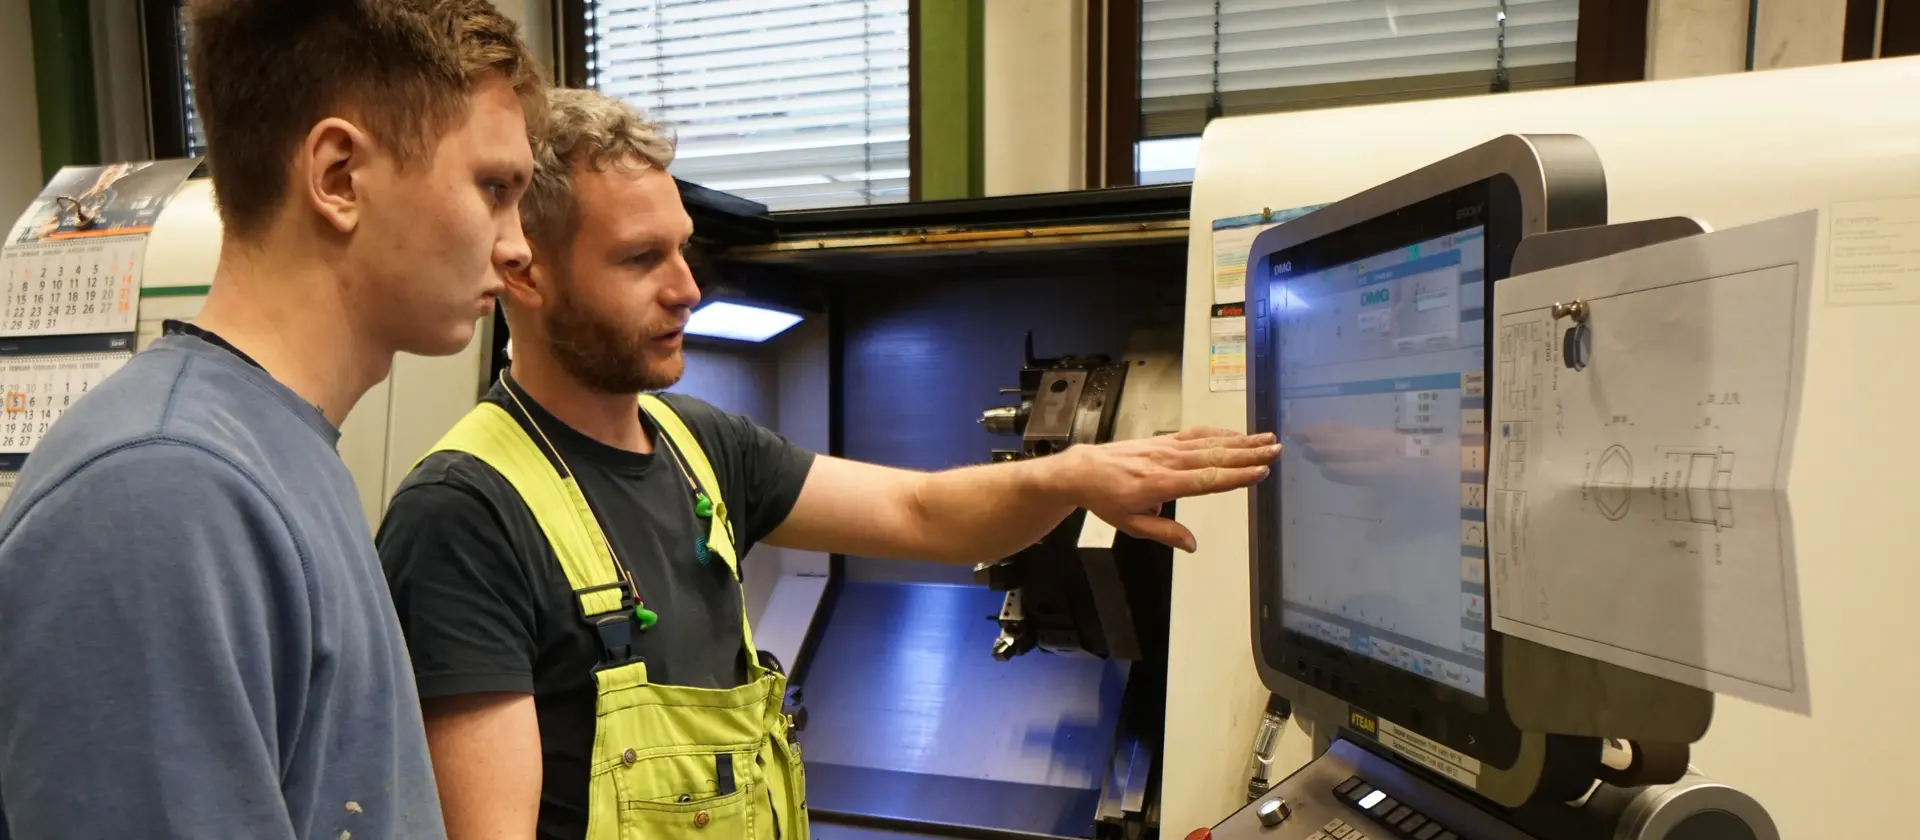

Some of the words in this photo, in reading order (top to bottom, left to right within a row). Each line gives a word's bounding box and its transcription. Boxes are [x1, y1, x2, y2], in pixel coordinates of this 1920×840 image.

[40, 268, 47, 278] 2
[58, 266, 64, 277] 3
[75, 265, 81, 275] 4
[92, 264, 99, 274] 5
[1274, 260, 1292, 276] DMG
[22, 282, 28, 292] 8
[39, 281, 46, 291] 9
[52, 279, 63, 290] 10
[69, 278, 79, 289] 11
[87, 277, 97, 288] 12
[104, 276, 115, 286] 13
[17, 294, 27, 305] 15
[34, 294, 44, 304] 16
[51, 292, 61, 303] 17
[68, 292, 78, 302] 18
[85, 290, 96, 301] 19
[101, 289, 114, 300] 20
[1361, 288, 1390, 306] DMG
[13, 307, 25, 318] 22
[30, 306, 42, 317] 23
[47, 305, 60, 316] 24
[65, 304, 77, 315] 25
[82, 304, 94, 314] 26
[100, 302, 112, 313] 27
[11, 320, 23, 330] 29
[28, 319, 40, 330] 30
[45, 318, 57, 329] 31
[82, 382, 88, 392] 2
[13, 396, 19, 407] 5
[30, 396, 36, 407] 6
[47, 396, 52, 406] 7
[64, 396, 69, 406] 8
[8, 410, 17, 420] 12
[25, 410, 34, 420] 13
[41, 409, 51, 420] 14
[6, 423, 16, 434] 19
[22, 423, 33, 433] 20
[39, 423, 48, 433] 21
[3, 436, 14, 446] 26
[20, 436, 31, 446] 27
